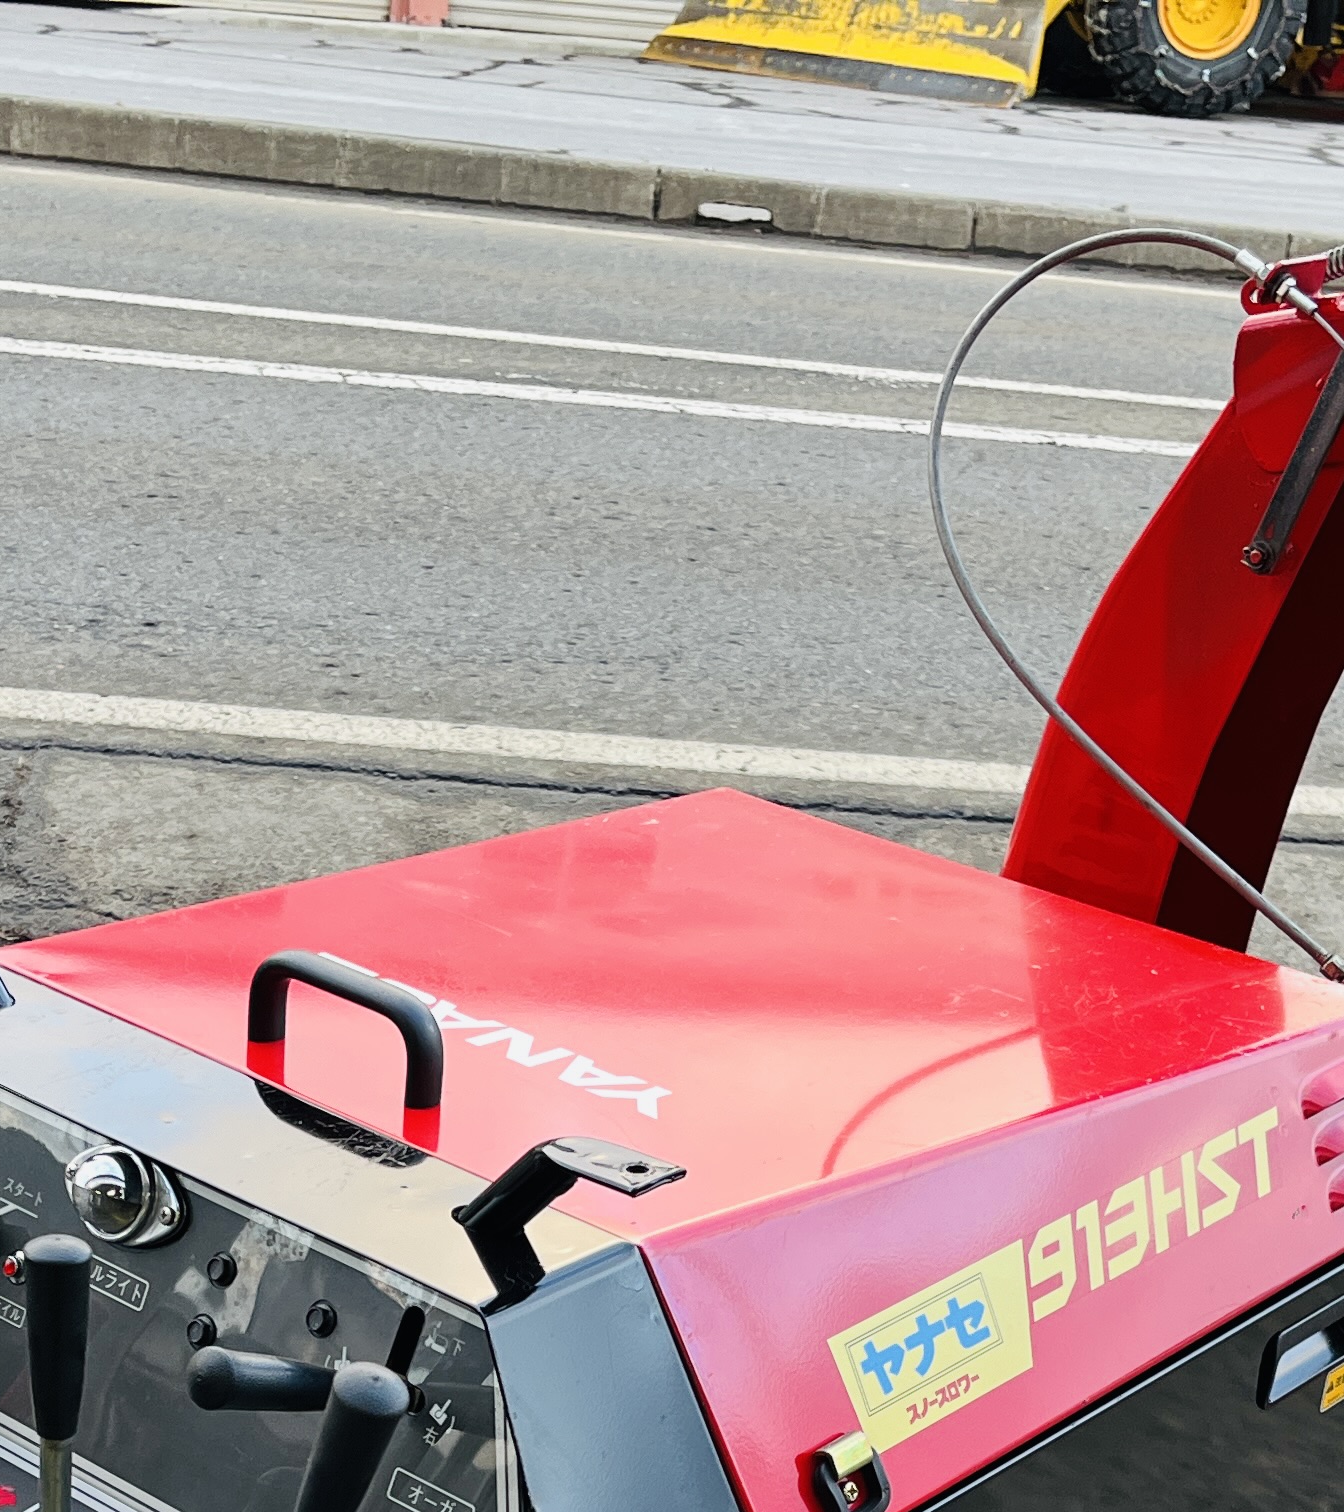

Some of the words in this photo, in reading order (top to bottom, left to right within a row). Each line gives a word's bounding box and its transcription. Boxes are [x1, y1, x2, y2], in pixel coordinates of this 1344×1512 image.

[3, 1178, 43, 1207] スタート
[1028, 1106, 1279, 1323] 913HST
[90, 1264, 142, 1303] ルライト
[860, 1296, 991, 1396] ヤナセ
[906, 1372, 980, 1425] スノースロワー
[422, 1426, 439, 1447] 右
